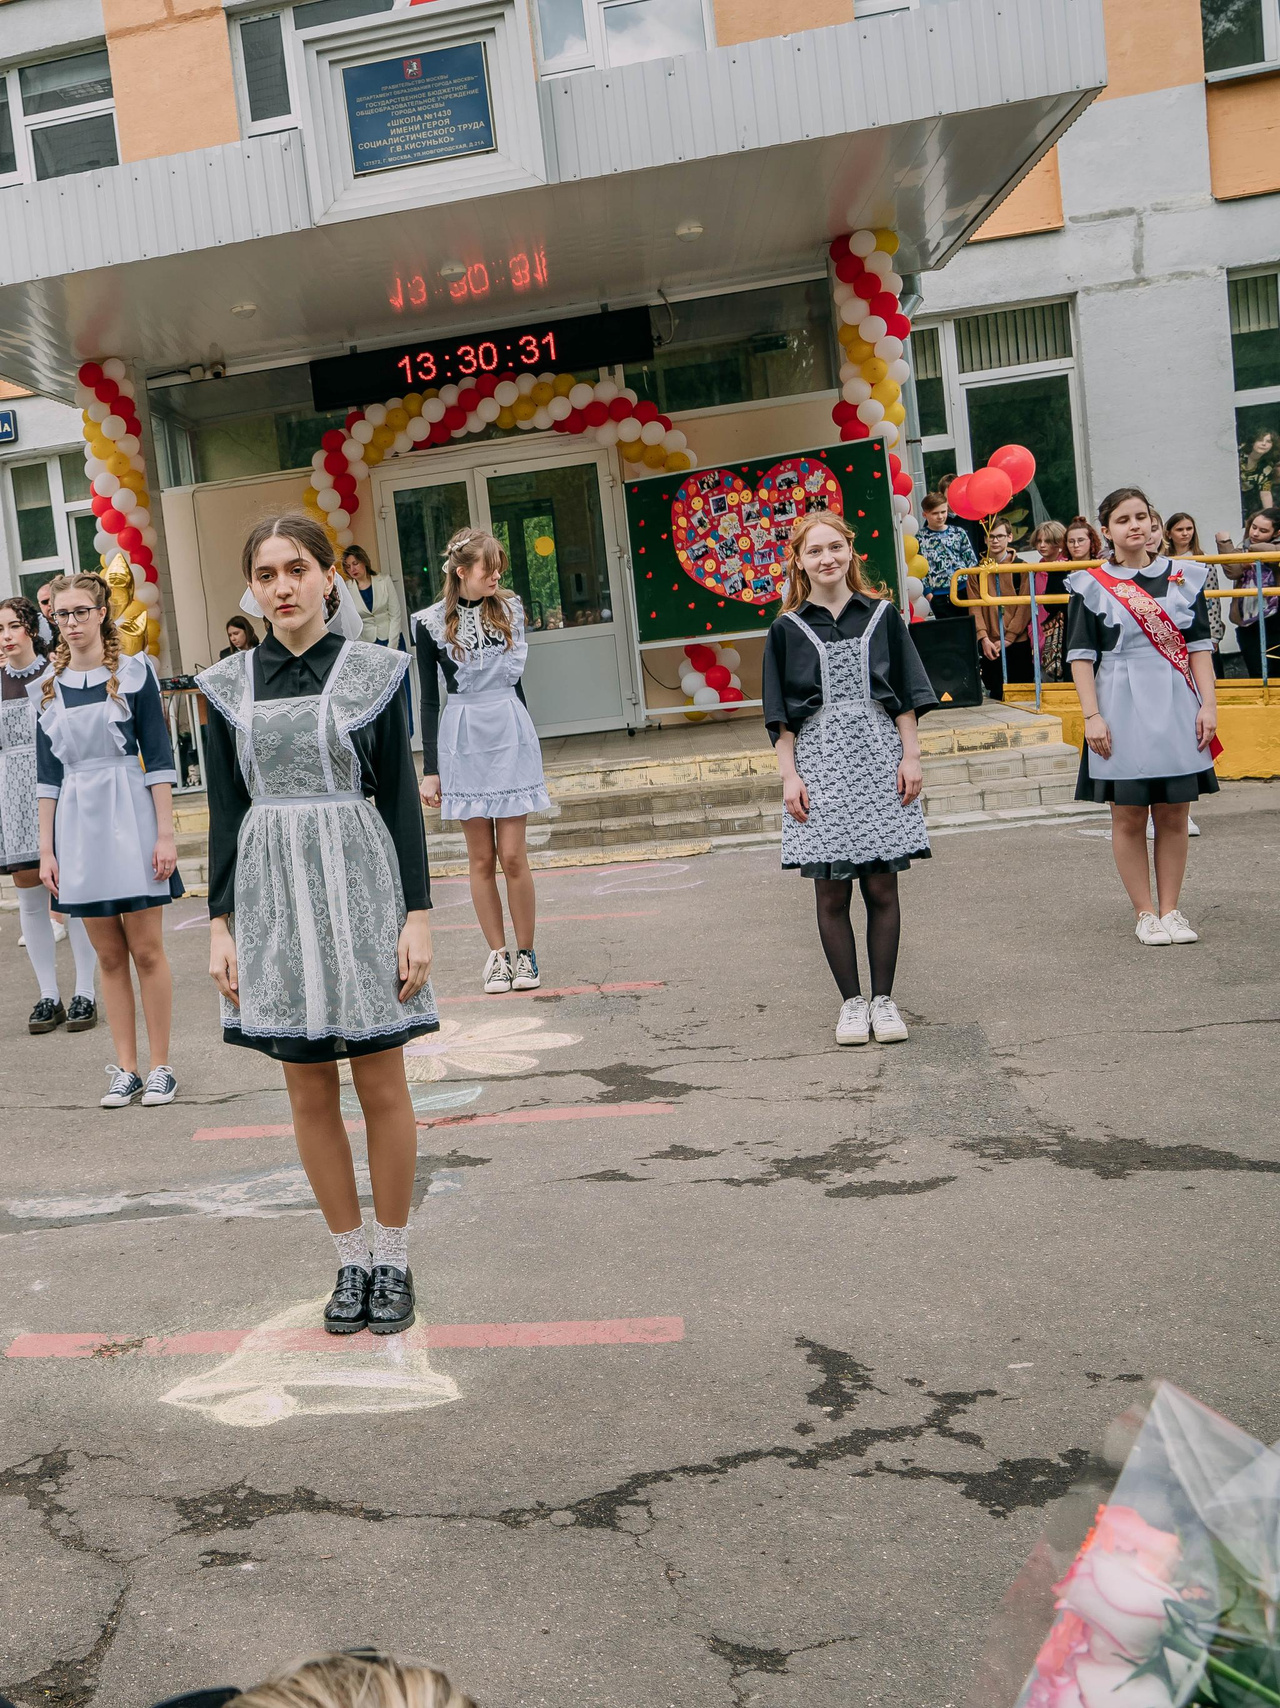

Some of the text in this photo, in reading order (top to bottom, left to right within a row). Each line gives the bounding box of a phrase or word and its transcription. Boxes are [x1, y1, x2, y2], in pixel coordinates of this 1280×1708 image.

[426, 74, 449, 83] МОСКВЫ
[355, 88, 480, 117] ОБЩЕОБРАЗОВАТЕЛЬНОЕ УЧРЕЖДЕНИЕ
[356, 91, 393, 103] ДЕПАРТАМЕНТ
[393, 84, 431, 96] ОБРАЗОВАНИЯ
[431, 80, 453, 89] ГОРОДА
[365, 84, 468, 109] ГОСУДАРСТВЕННОЕ БЮДЖЕТНОЕ
[387, 109, 452, 127] «ШКОЛА №1430
[391, 102, 445, 117] ГОРОДА МОСКВЫ
[358, 121, 485, 150] СОЦИАЛИСТИЧЕСКОГО ТРУДА
[390, 118, 450, 136] ИМЕНИ ГЕРОЯ
[397, 331, 557, 383] 13:30:31
